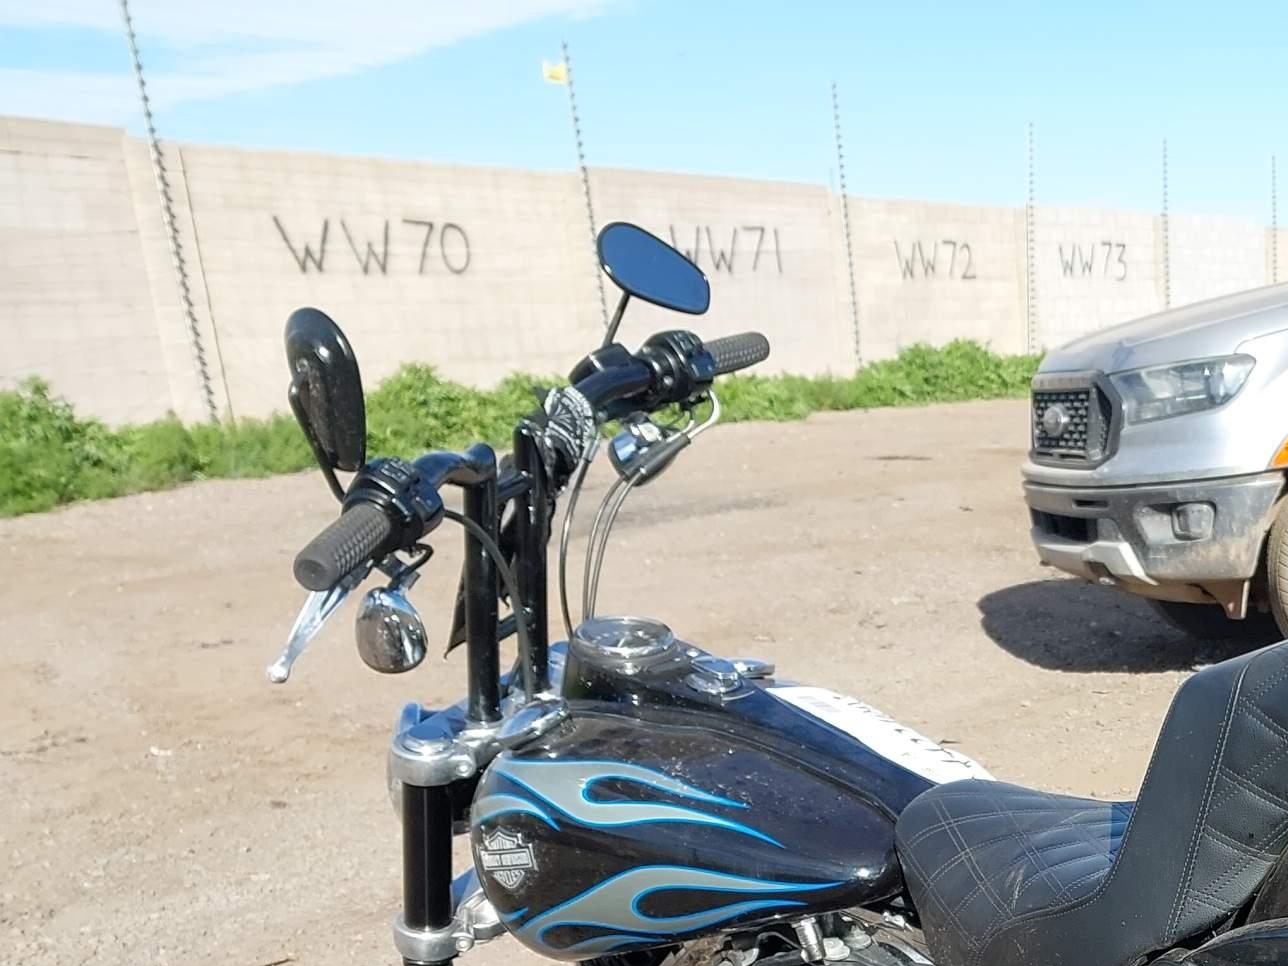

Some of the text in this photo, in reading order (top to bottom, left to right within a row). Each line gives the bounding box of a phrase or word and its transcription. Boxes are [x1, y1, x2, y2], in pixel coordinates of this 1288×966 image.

[272, 215, 472, 275] WW70
[894, 238, 977, 280] WW72
[1058, 240, 1129, 281] WW73
